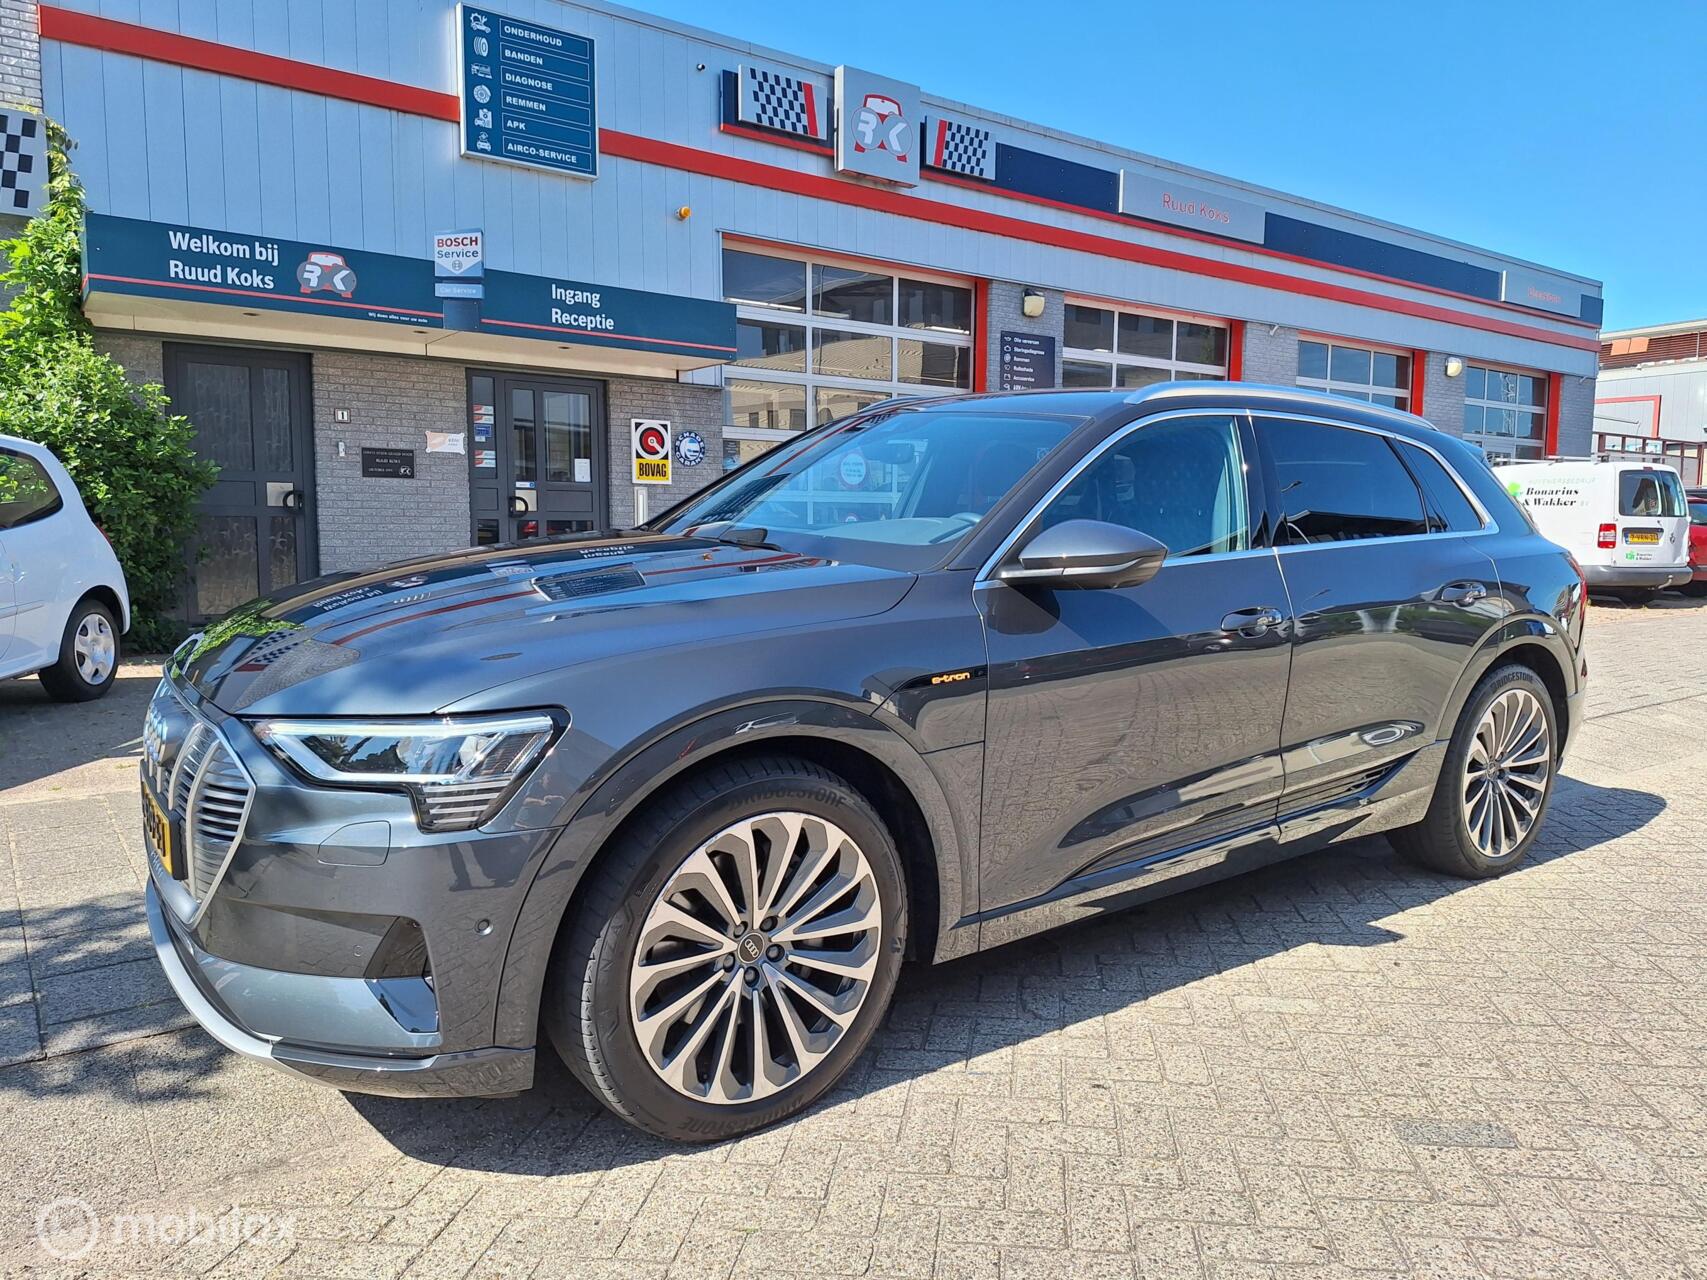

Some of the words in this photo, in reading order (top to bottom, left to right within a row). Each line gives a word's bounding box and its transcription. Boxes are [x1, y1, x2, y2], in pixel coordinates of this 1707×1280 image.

[504, 26, 562, 46] ONDERHOUD
[505, 50, 543, 65] BANDEN
[505, 73, 553, 91] DIAGNOSE
[506, 96, 546, 111] REMMEN
[506, 119, 526, 130] APK
[507, 143, 577, 163] AIRCO-SERVICE
[1162, 192, 1196, 215] Ruud
[1200, 202, 1230, 224] Koks
[168, 230, 250, 258] Welkom
[254, 241, 279, 266] bij
[437, 236, 478, 247] BOSCH
[437, 248, 479, 258] Service
[169, 260, 222, 283] Ruud
[227, 267, 274, 289] Koks
[551, 284, 600, 308] Ingang
[551, 308, 614, 330] Receptie
[639, 463, 667, 478] BOVAG
[1534, 498, 1577, 506] Wakker
[931, 672, 970, 684] e-tron
